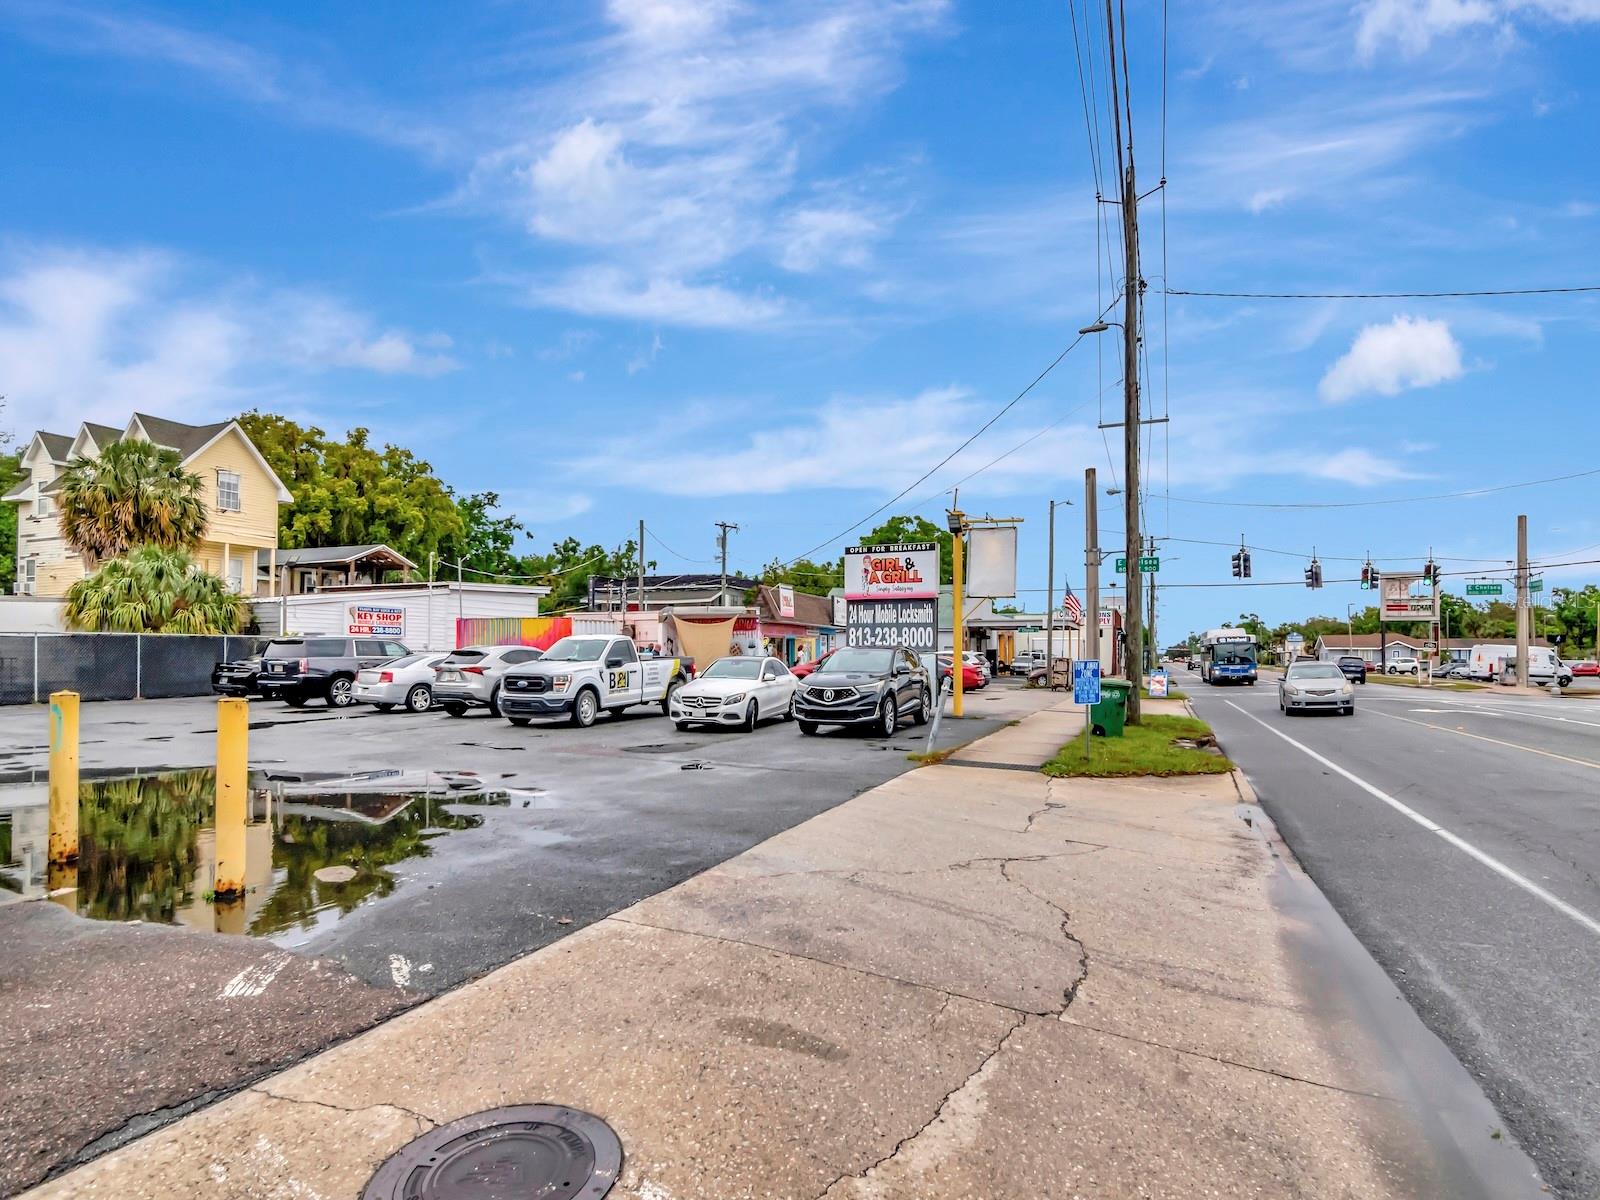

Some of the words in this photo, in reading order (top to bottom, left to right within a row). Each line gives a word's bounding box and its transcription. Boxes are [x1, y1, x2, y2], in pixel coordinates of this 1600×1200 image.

[889, 544, 930, 552] BREAKFAST
[870, 557, 904, 572] GIRL
[905, 557, 915, 570] &
[869, 571, 880, 584] A
[881, 569, 923, 584] GRILL
[376, 613, 401, 621] SHOP
[849, 604, 858, 623] 24
[858, 604, 874, 624] Hour
[875, 603, 897, 624] Mobile
[898, 603, 934, 624] Locksmith
[848, 627, 933, 647] 813-238-8000
